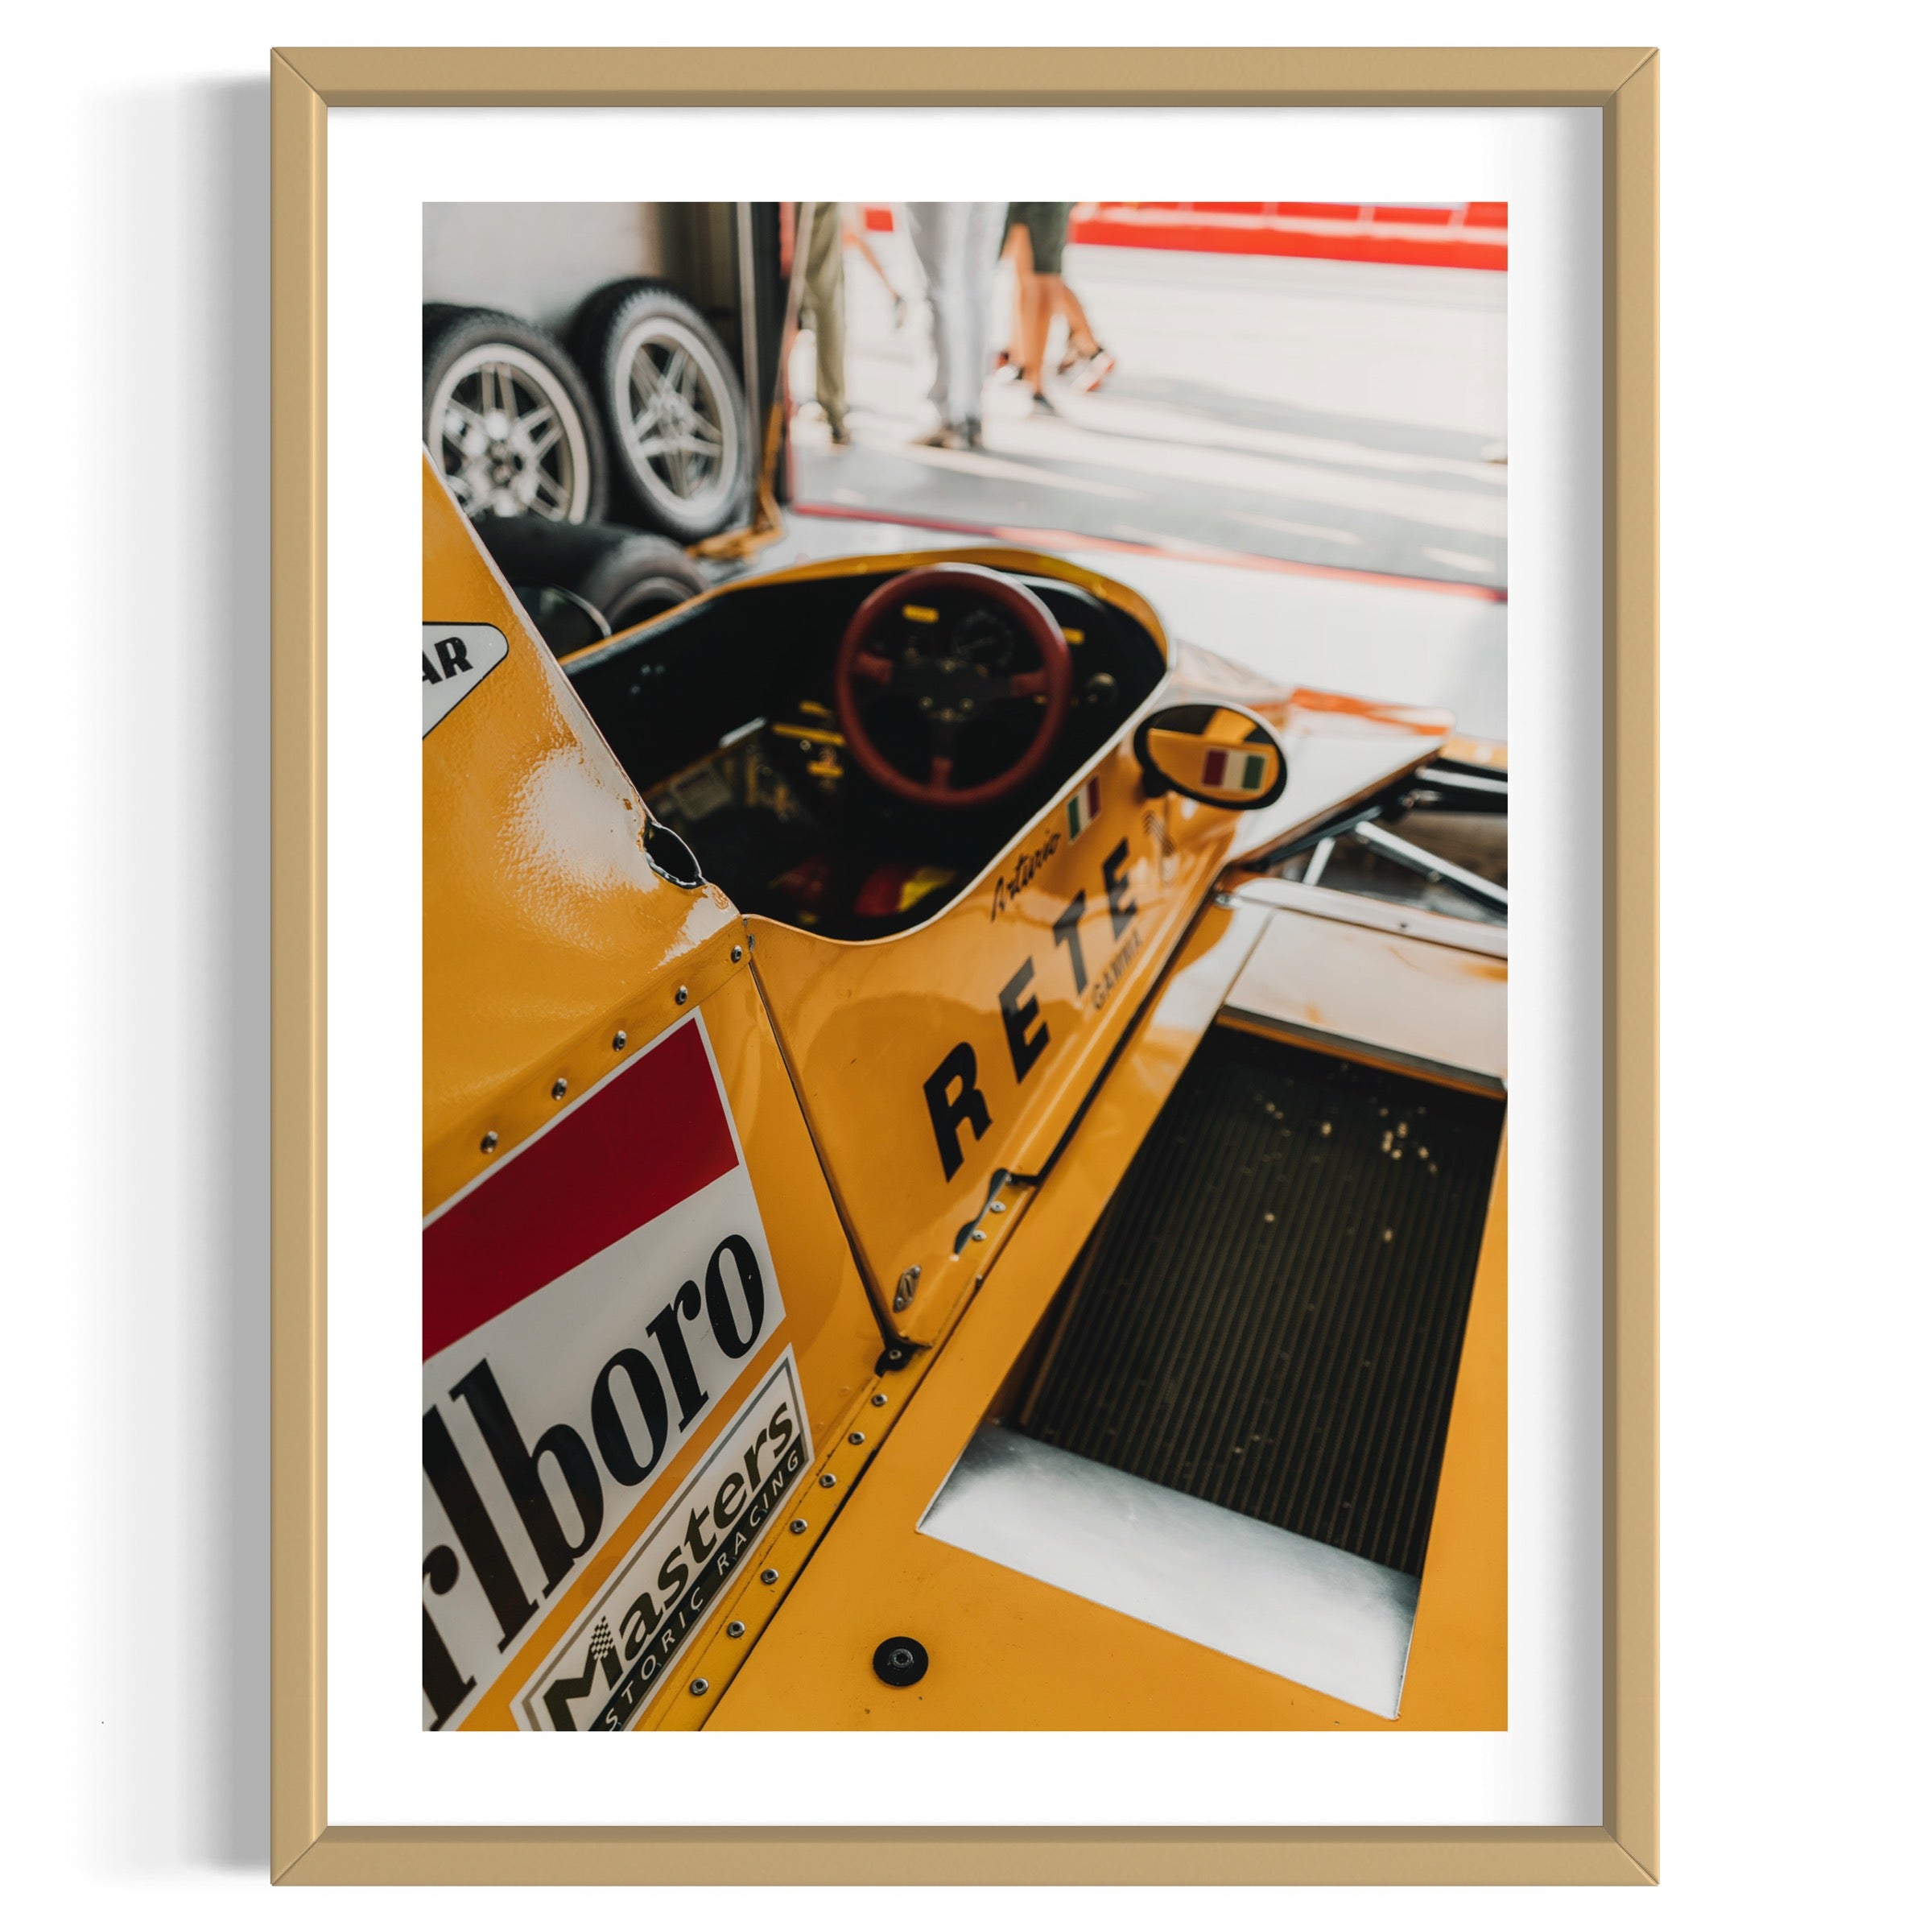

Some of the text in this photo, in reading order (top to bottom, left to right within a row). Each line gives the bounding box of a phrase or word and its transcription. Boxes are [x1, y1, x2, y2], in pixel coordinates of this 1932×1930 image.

[923, 837, 1137, 1183] RETE
[543, 1402, 793, 1731] Masters
[605, 1450, 799, 1731] STORIC RACING
